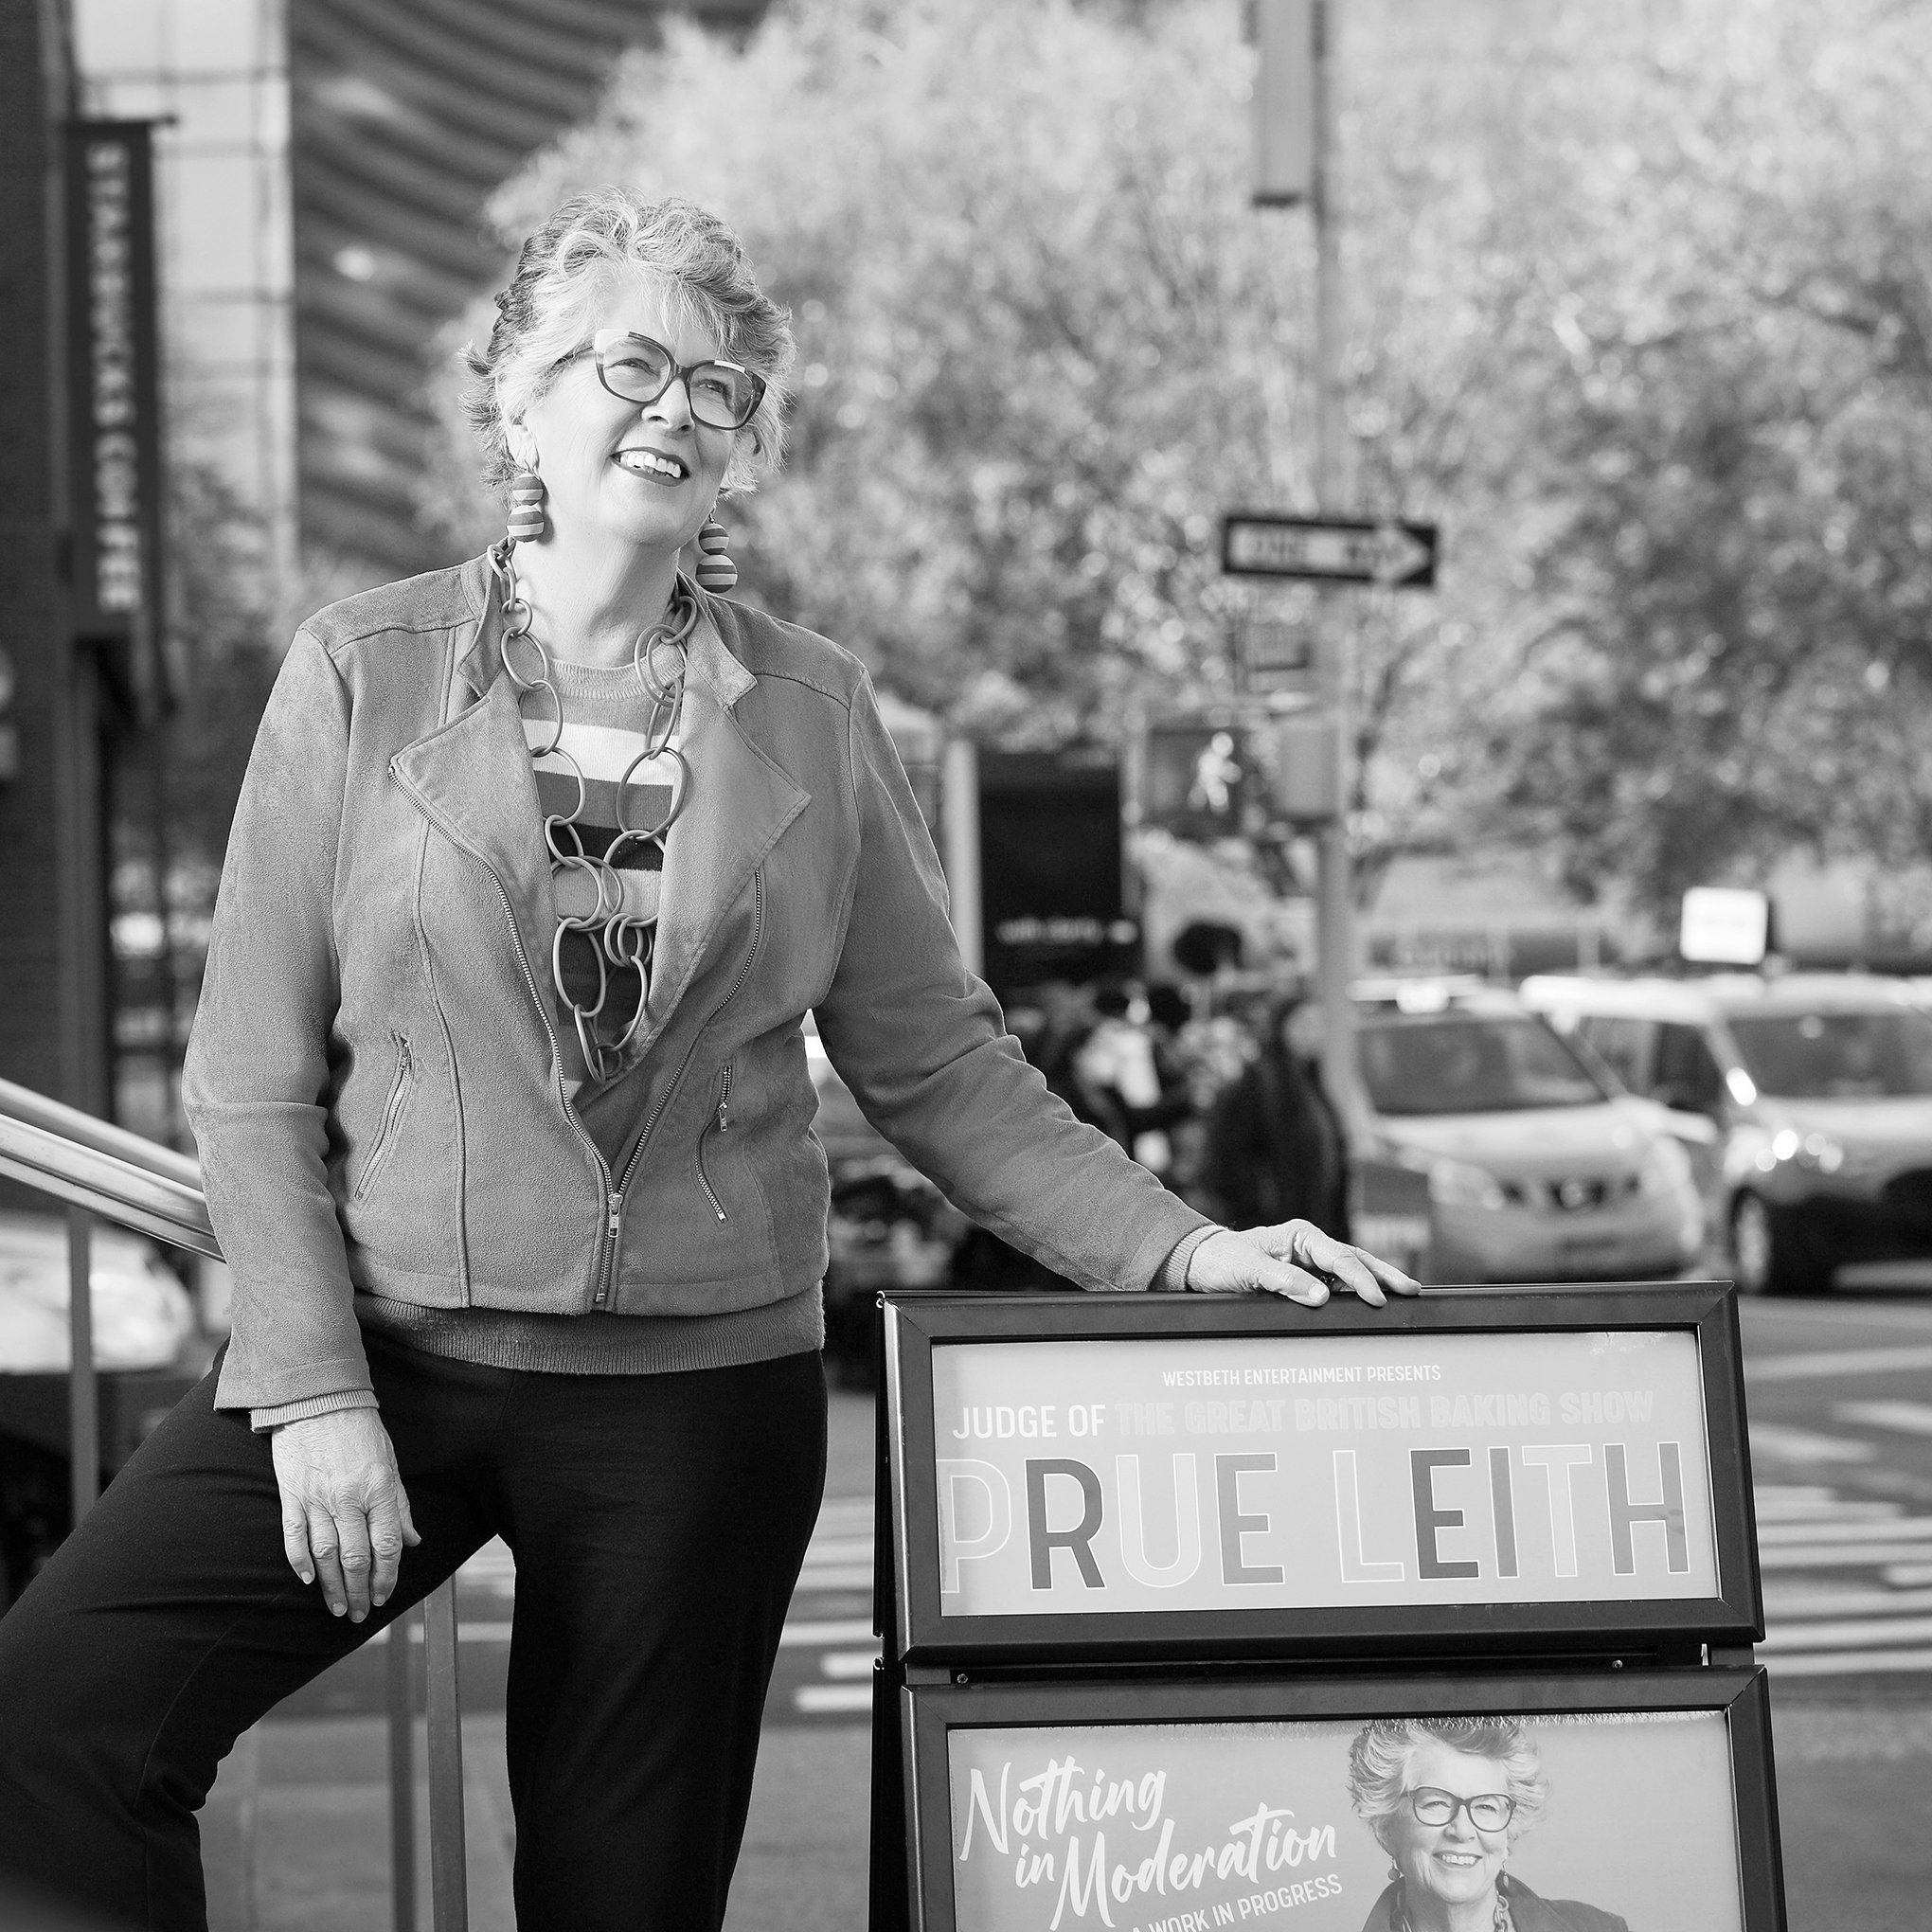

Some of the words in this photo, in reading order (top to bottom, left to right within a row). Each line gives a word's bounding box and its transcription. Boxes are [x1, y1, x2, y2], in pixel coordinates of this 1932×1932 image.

[953, 1405, 1057, 1440] JUDGE
[1067, 1404, 1105, 1437] OF
[1115, 1402, 1174, 1436] THE
[1184, 1399, 1286, 1434] GREAT
[1295, 1395, 1421, 1431] BRITISH
[1430, 1392, 1550, 1428] BAKING
[1560, 1390, 1654, 1425] SHOW
[1162, 1369, 1240, 1387] WESTBETH
[1243, 1367, 1362, 1386] ENTERTAINMENT
[1367, 1365, 1441, 1383] PRESENTS
[936, 1453, 1285, 1593] PRUE
[1333, 1440, 1690, 1583] LEITH
[958, 1755, 1167, 1862] Nothing
[1015, 1843, 1055, 1888] in
[1049, 1801, 1337, 1931] Moderation
[1211, 1903, 1236, 1926] IN
[1237, 1873, 1343, 1920] PROGRESS
